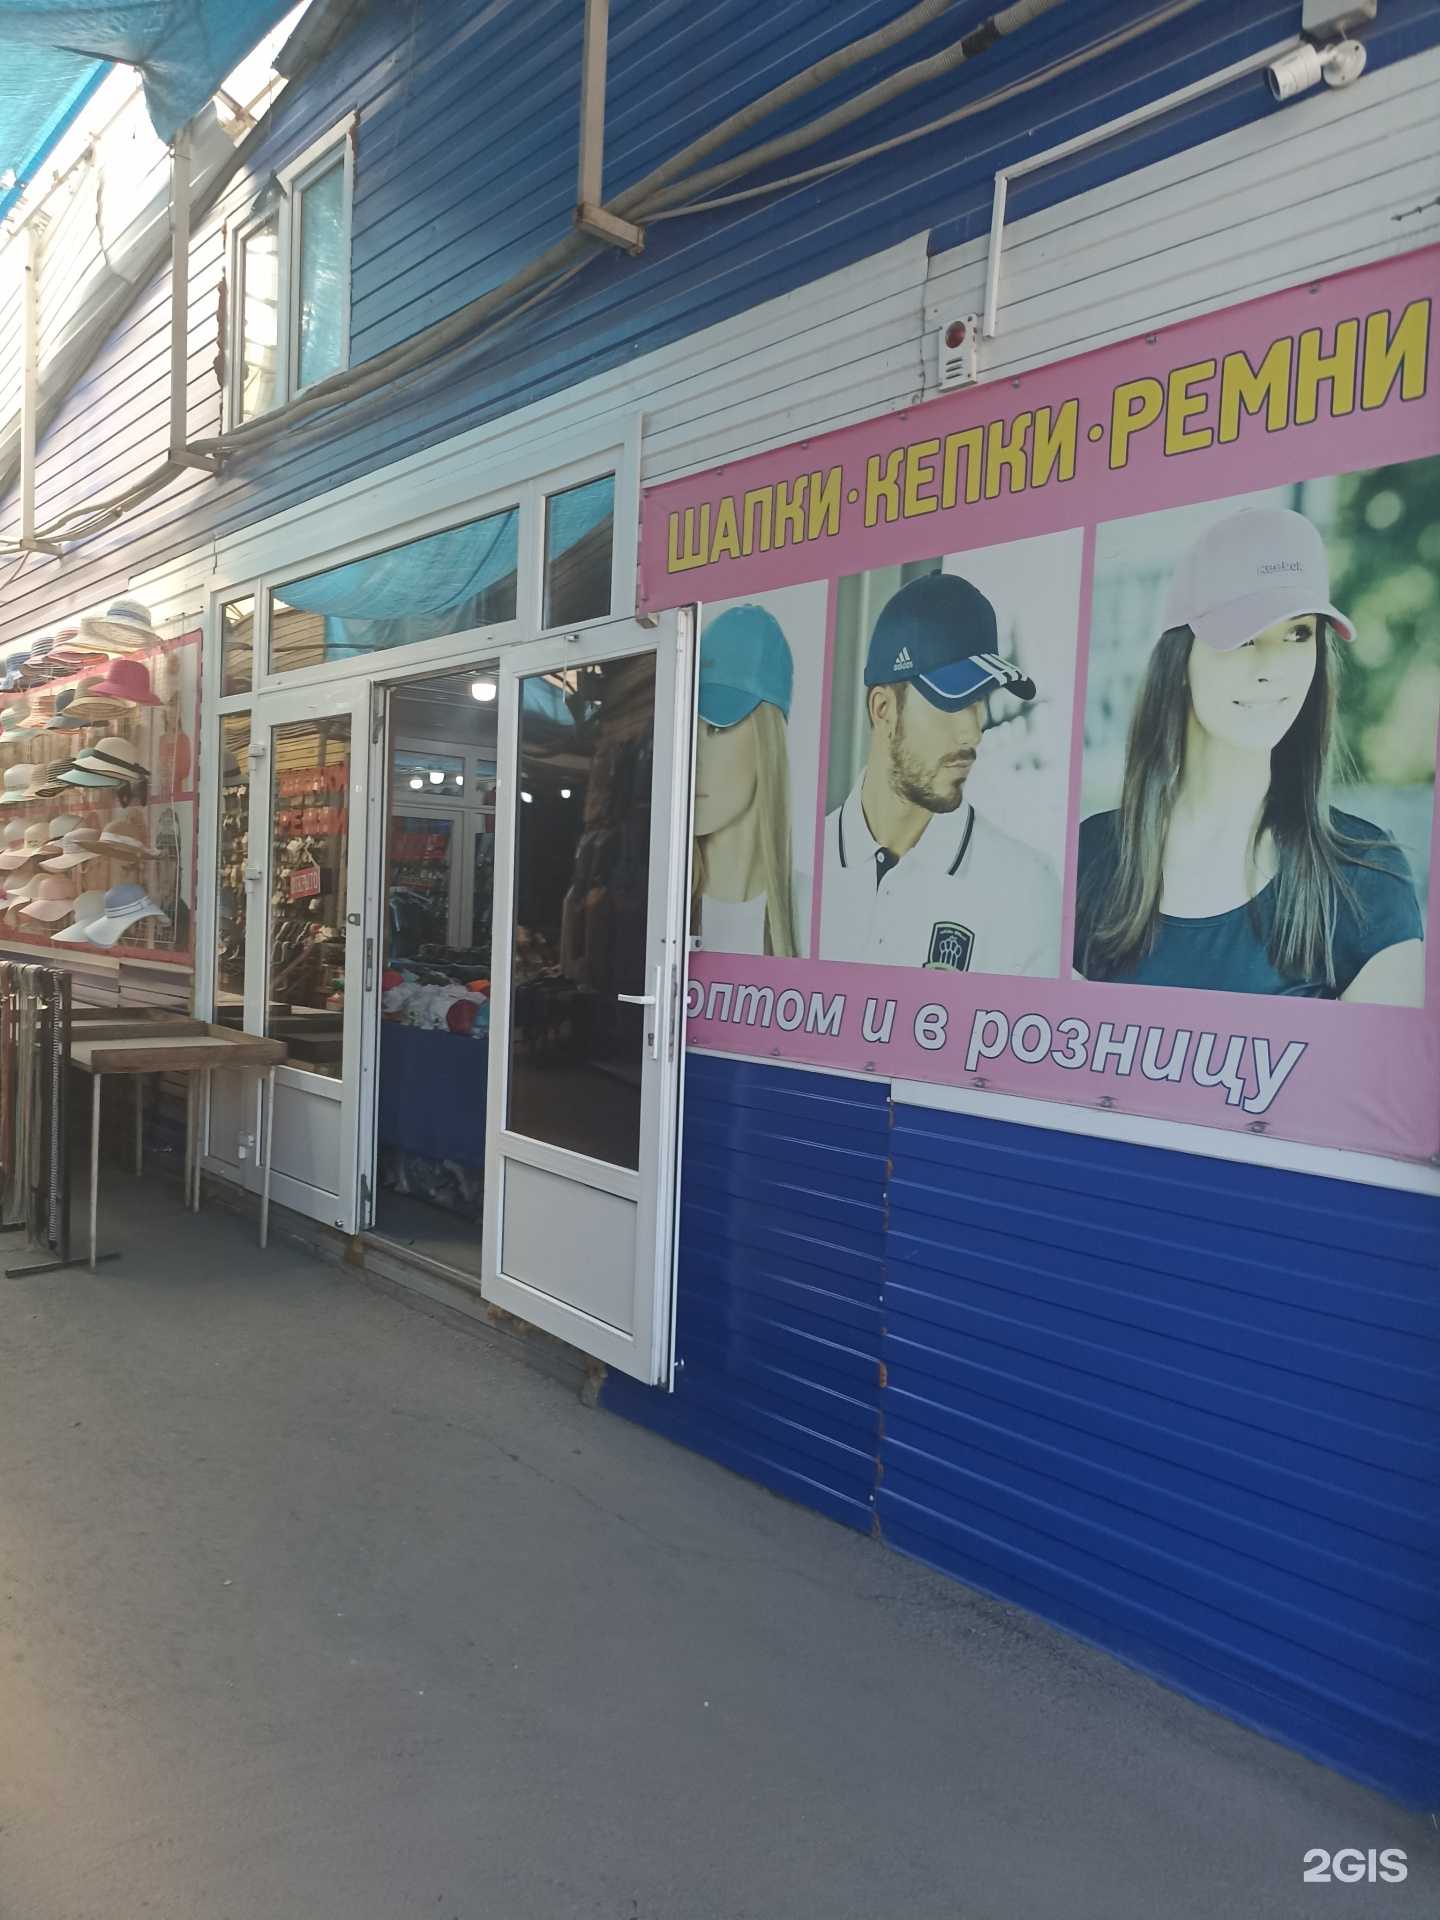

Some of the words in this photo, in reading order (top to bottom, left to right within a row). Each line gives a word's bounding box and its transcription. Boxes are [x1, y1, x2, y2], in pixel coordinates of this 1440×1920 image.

[667, 465, 843, 574] ШАПКИ
[864, 399, 1080, 528] КЕПКИ
[1108, 298, 1432, 470] РЕМНИ
[860, 997, 898, 1043] и
[913, 1002, 948, 1051] в
[963, 1007, 1308, 1114] розницу
